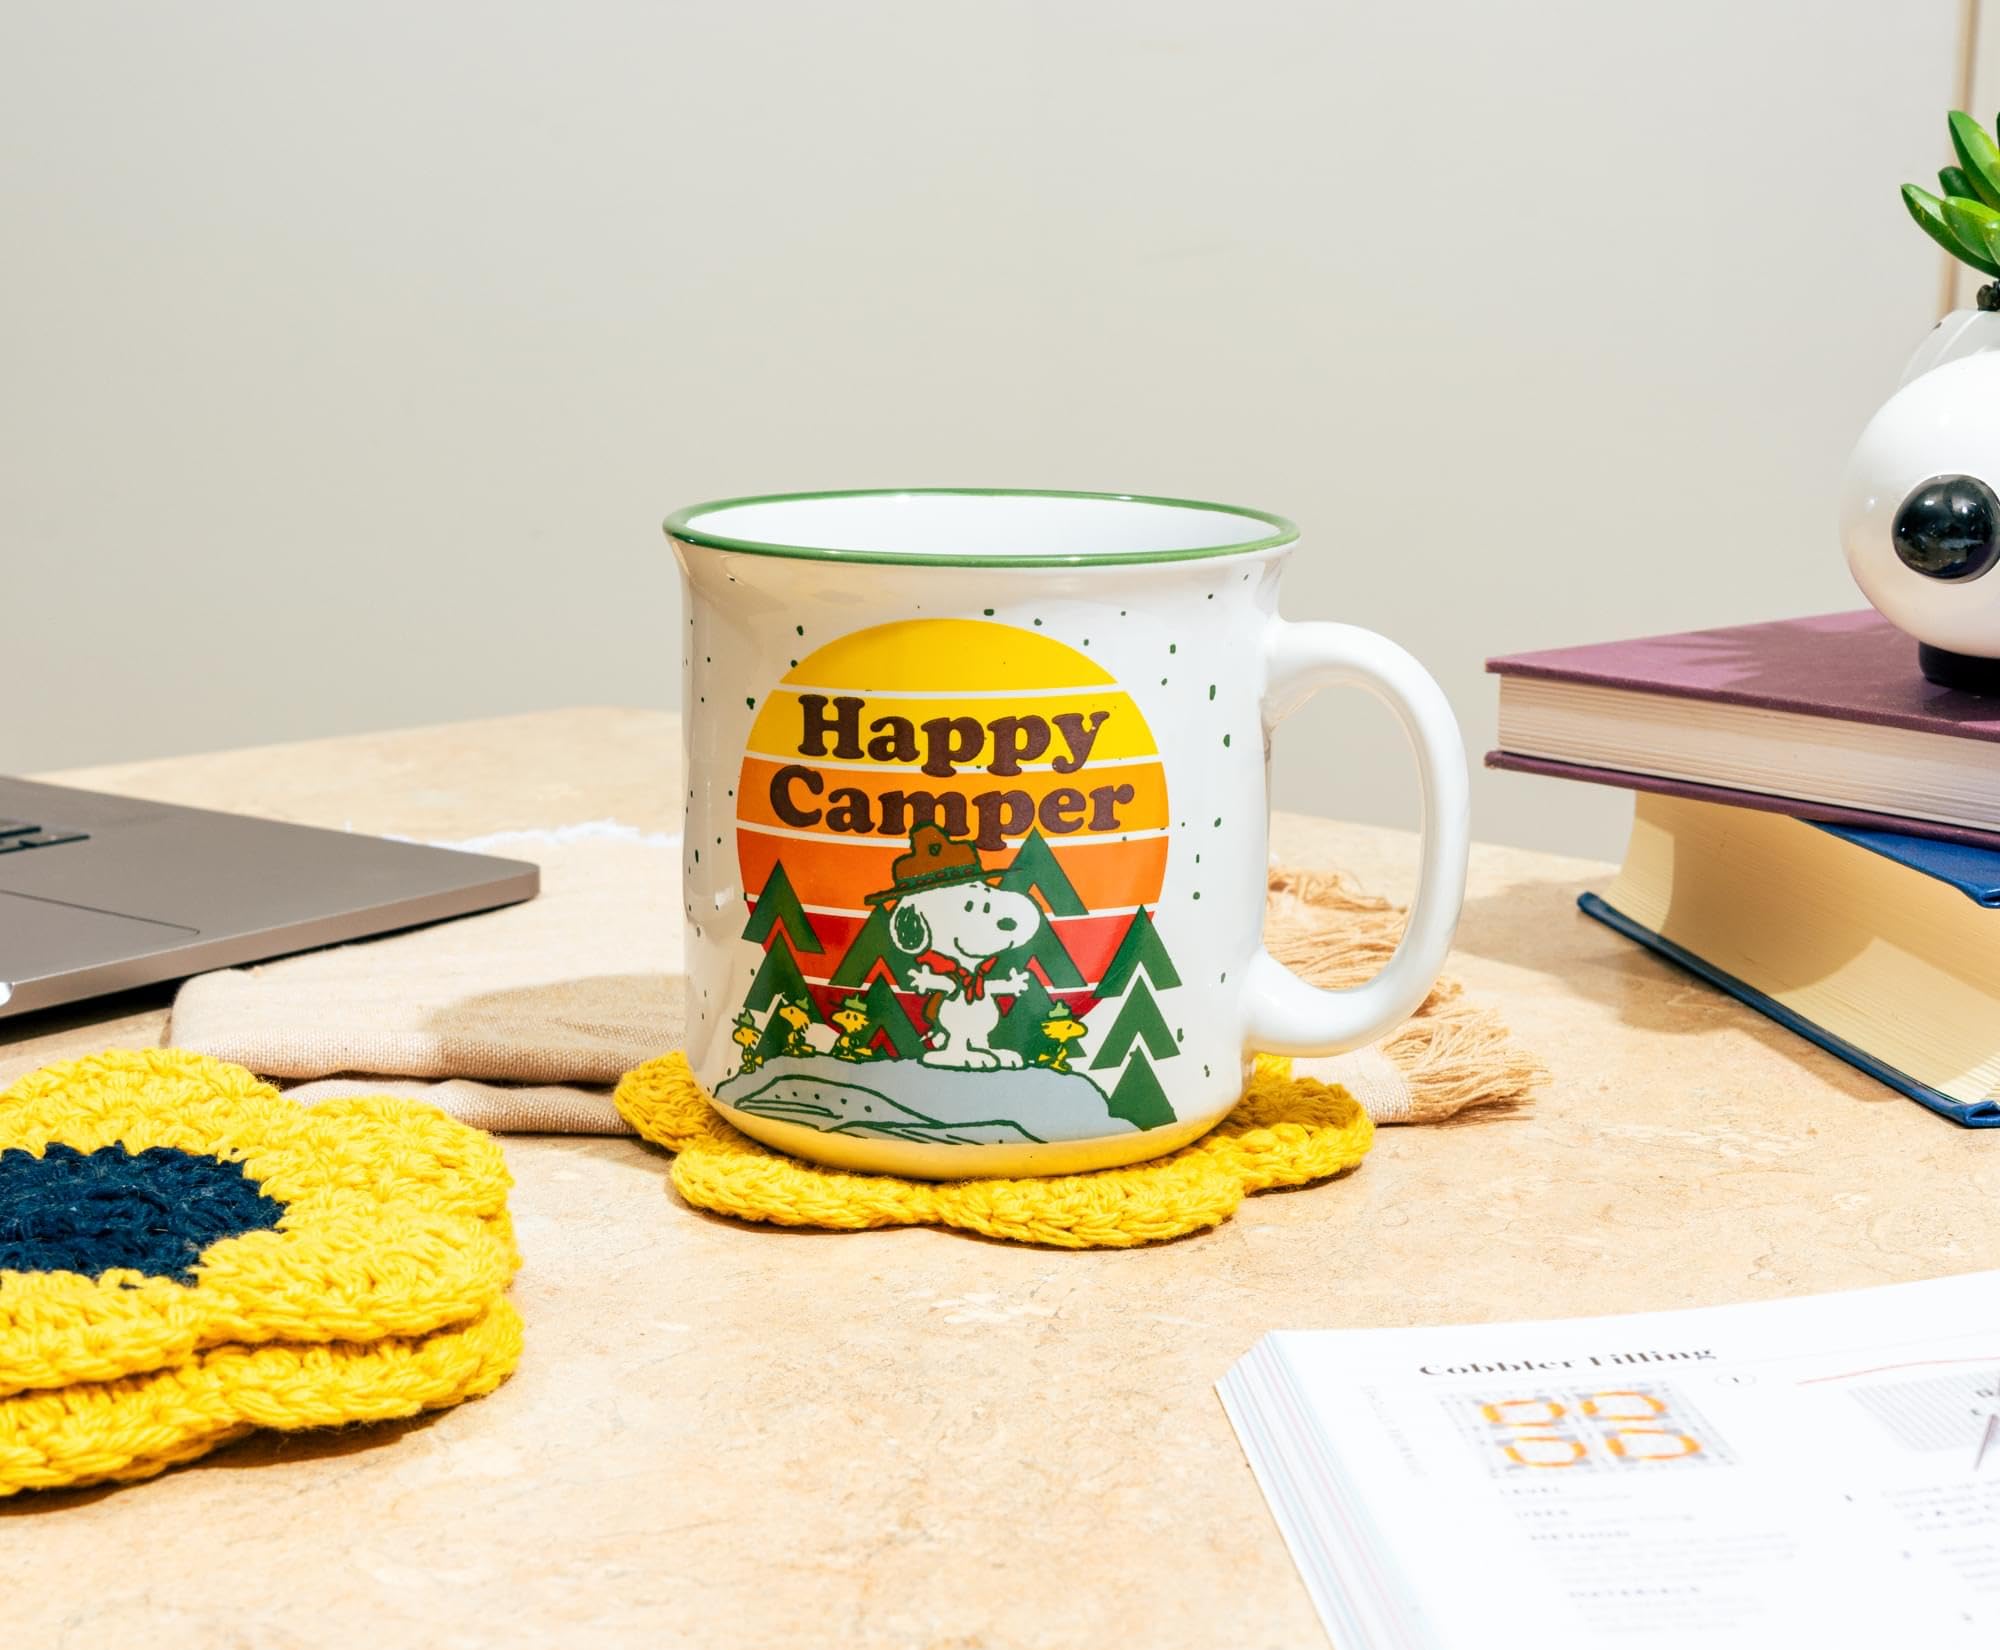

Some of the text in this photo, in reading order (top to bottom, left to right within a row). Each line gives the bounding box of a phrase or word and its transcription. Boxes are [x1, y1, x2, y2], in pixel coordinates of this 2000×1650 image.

[797, 694, 1110, 778] Happy
[769, 764, 1135, 852] Camper
[1418, 1359, 1576, 1376] Cobbler
